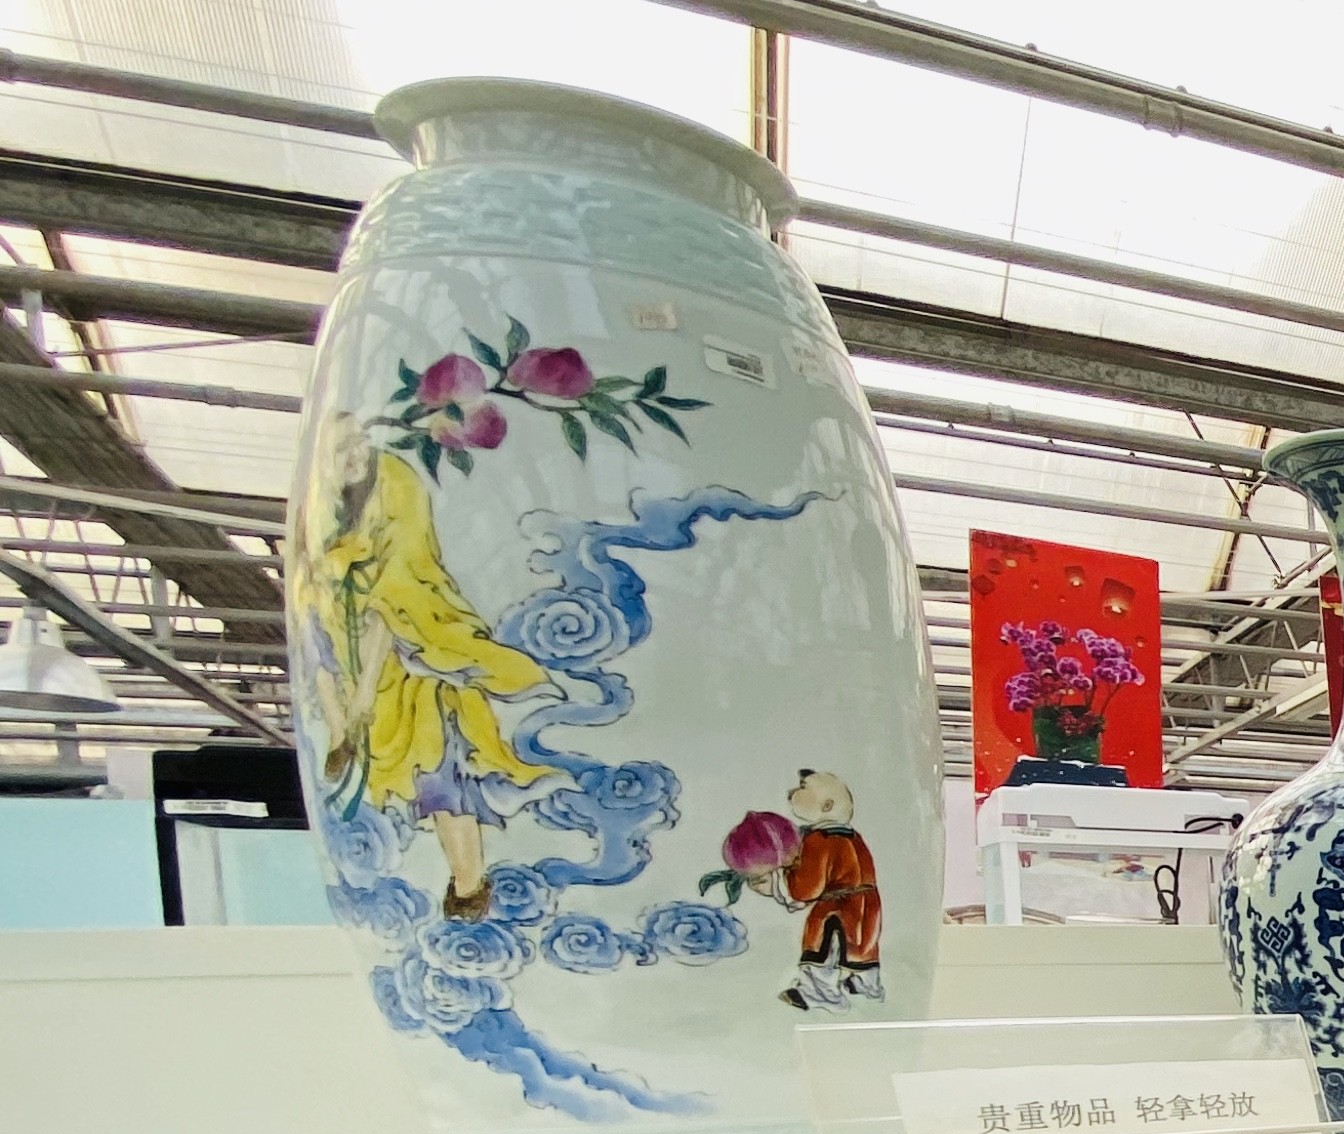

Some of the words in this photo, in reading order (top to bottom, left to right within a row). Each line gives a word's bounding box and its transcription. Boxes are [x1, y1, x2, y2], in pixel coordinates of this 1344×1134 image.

[977, 1098, 1116, 1134] 贵重物品
[1134, 1091, 1259, 1124] 轻拿轻放
